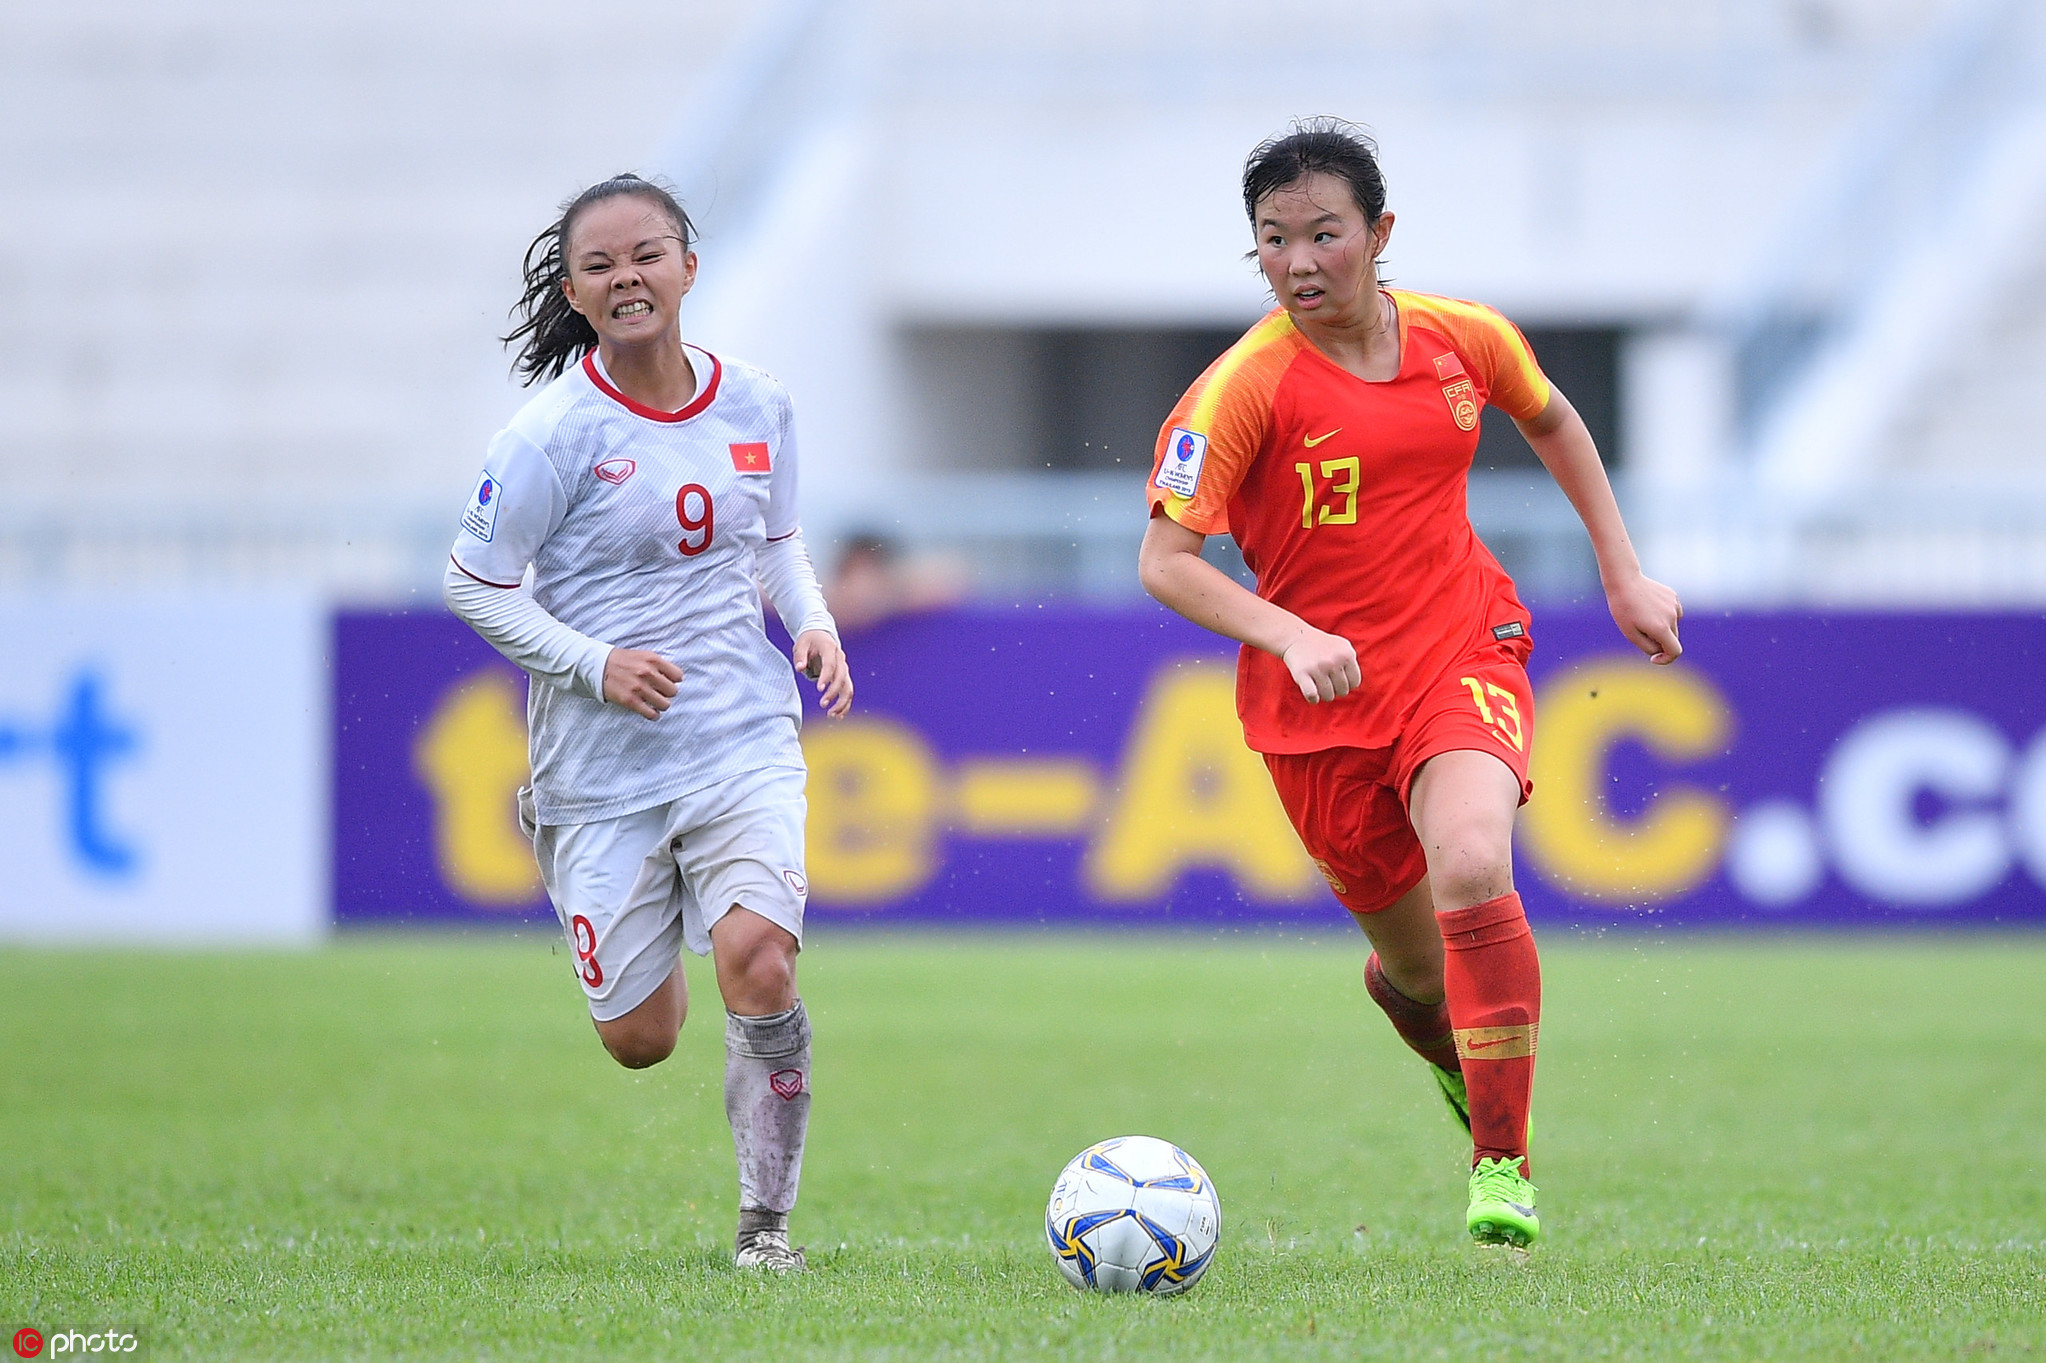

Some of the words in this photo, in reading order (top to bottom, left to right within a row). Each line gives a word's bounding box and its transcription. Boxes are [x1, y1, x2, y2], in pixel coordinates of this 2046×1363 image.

[1446, 383, 1471, 398] CFA
[1175, 463, 1187, 472] AFC
[1295, 456, 1360, 529] 13
[675, 482, 713, 557] 9
[1460, 676, 1523, 752] 13
[572, 914, 604, 989] 9
